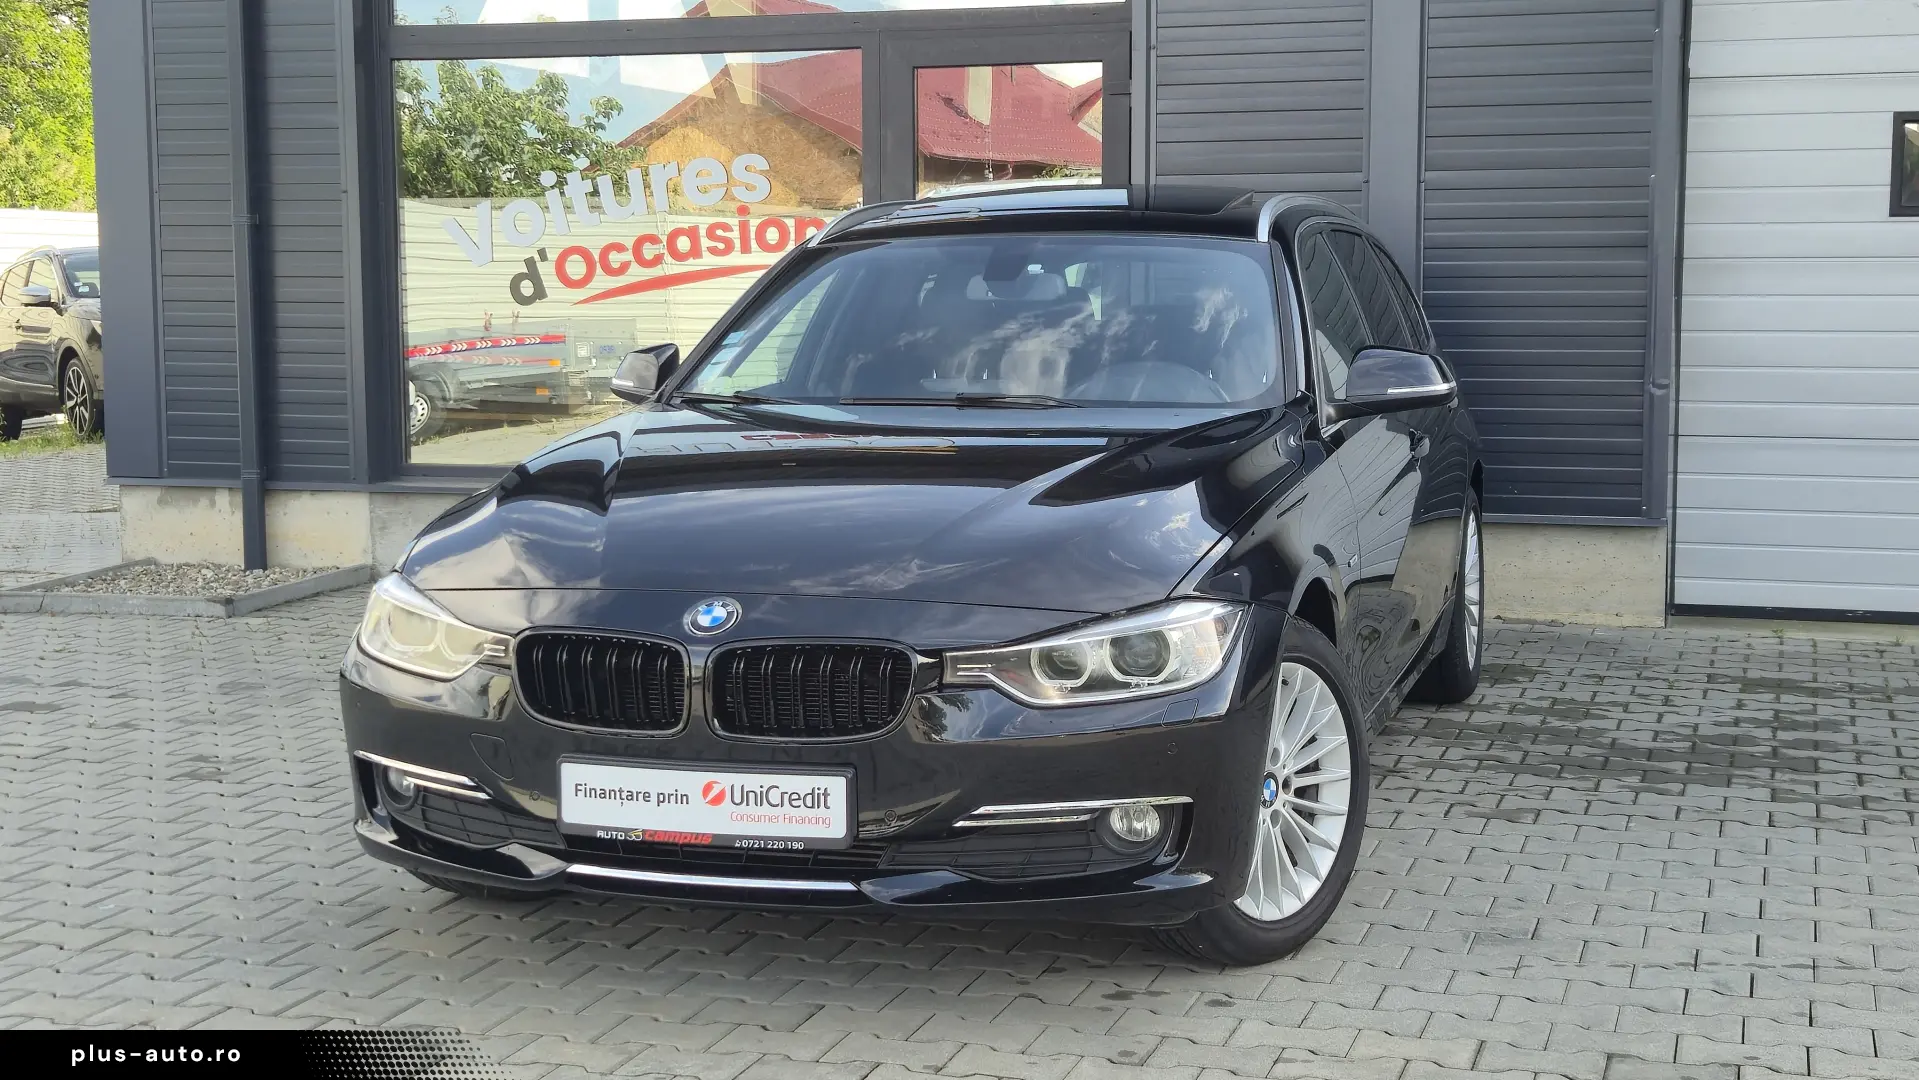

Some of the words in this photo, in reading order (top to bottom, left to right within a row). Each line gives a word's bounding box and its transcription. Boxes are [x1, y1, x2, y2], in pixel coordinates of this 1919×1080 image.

[441, 153, 771, 267] Voitures
[574, 783, 651, 806] Finanțare
[656, 788, 690, 805] prin
[730, 784, 831, 809] UniCredit
[730, 811, 781, 824] Consumer
[783, 814, 831, 828] Financing
[597, 830, 625, 840] AUTO
[742, 840, 764, 848] 0721
[767, 841, 785, 849] 220
[787, 841, 804, 849] 190
